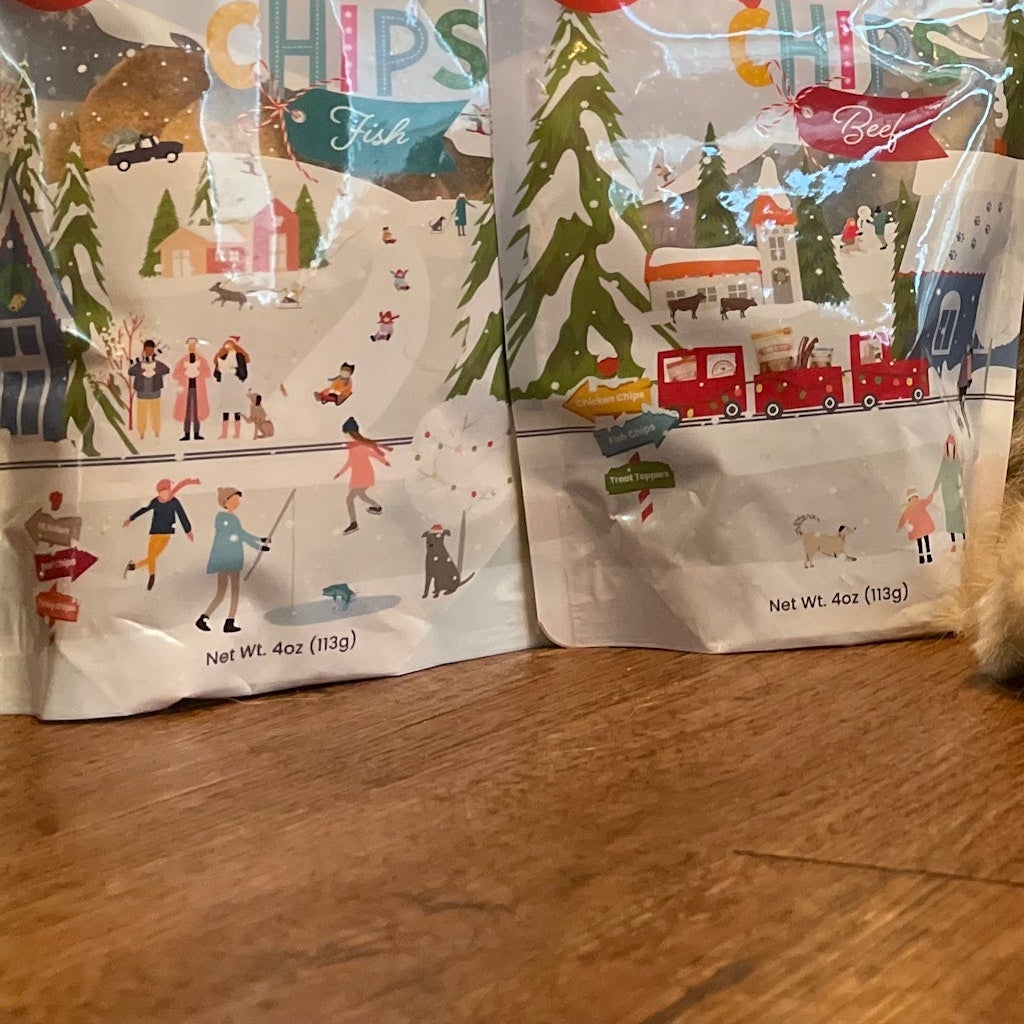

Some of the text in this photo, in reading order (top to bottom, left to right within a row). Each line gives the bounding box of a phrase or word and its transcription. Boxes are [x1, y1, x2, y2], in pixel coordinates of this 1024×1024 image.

[728, 0, 963, 95] CHIPS
[330, 106, 411, 151] Fish
[833, 103, 906, 153] Beef
[769, 582, 909, 612] Net Wt. 4oz (113g)
[206, 629, 356, 666] Net Wt. 4oz (113g)
